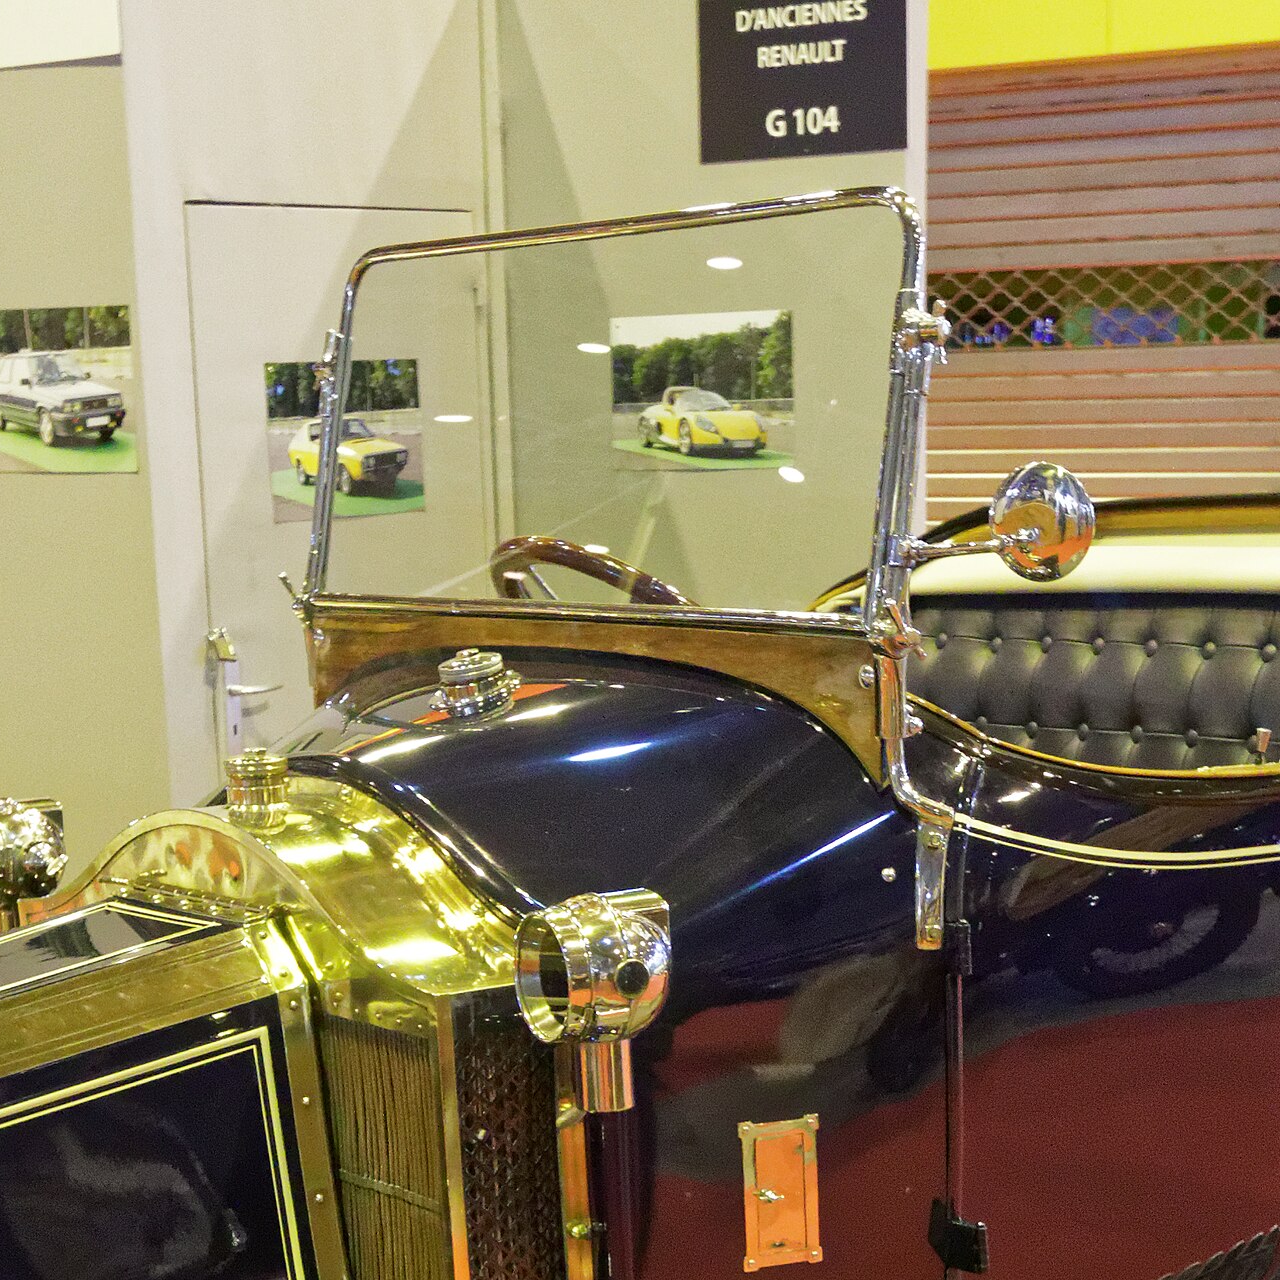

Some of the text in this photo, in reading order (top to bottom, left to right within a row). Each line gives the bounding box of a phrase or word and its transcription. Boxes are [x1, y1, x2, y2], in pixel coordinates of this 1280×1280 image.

[735, 1, 868, 32] D'ANCIENNES
[757, 39, 847, 68] RENAULT
[765, 105, 841, 137] G 104
